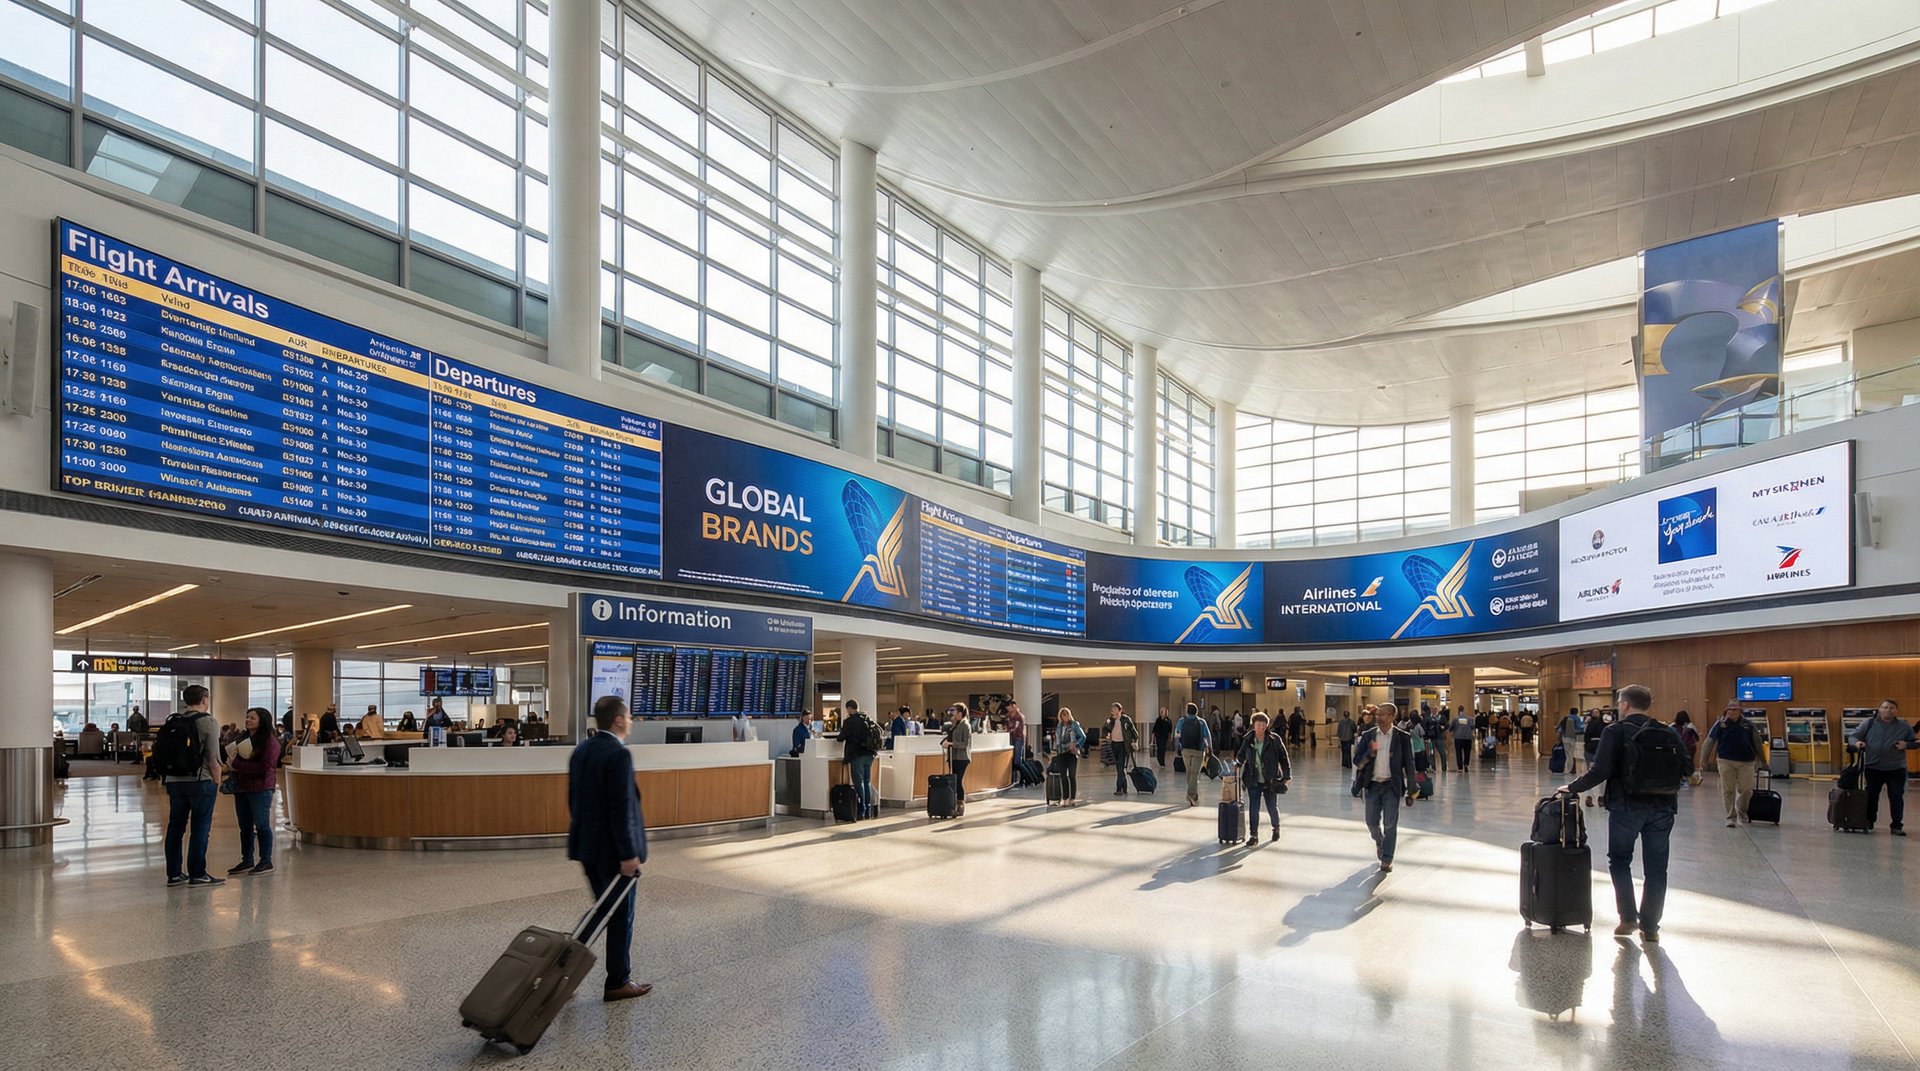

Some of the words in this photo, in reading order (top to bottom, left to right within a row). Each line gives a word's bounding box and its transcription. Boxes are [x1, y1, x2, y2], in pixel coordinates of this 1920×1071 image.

[68, 228, 157, 281] Flight
[165, 266, 269, 319] Arrivals
[435, 358, 536, 403] Departures
[64, 475, 91, 488] TOP
[705, 478, 812, 523] GLOBAL
[702, 512, 813, 555] BRANDS
[1281, 600, 1382, 615] INTERNATIONAL
[1303, 587, 1357, 600] Airlines
[619, 602, 732, 630] Information
